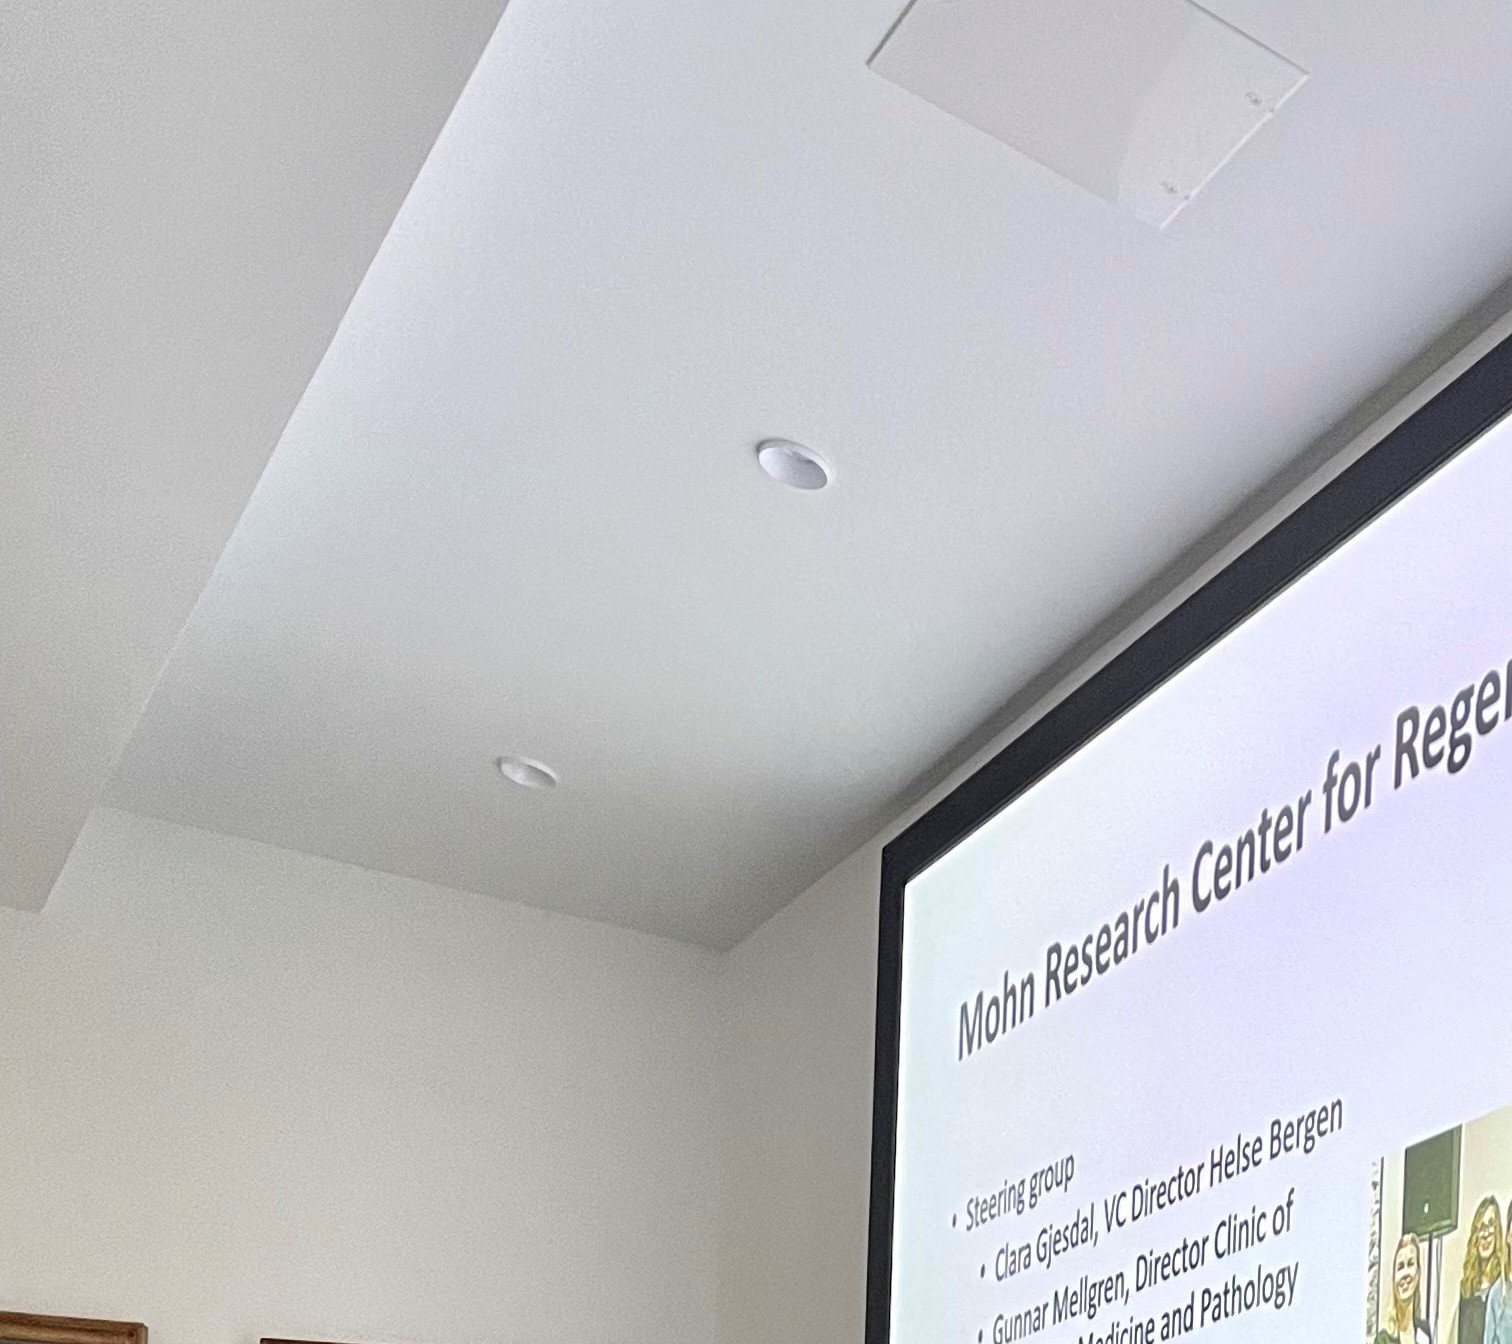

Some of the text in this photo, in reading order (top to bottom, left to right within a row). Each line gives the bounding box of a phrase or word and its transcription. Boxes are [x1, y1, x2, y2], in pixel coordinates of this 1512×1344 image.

[958, 971, 1034, 1060] Mohn
[1044, 864, 1180, 1008] Research
[1192, 790, 1312, 912] Center
[1323, 744, 1381, 833] for
[966, 1153, 1076, 1232] Steering group
[994, 1098, 1343, 1282] Clara Gjesdal, VC Director Helse Bergen
[1053, 1268, 1130, 1320] Mellgren,
[1135, 1233, 1210, 1292] Director
[1214, 1206, 1267, 1259] Clinic
[1271, 1187, 1295, 1238] of
[1160, 1291, 1195, 1343] and
[1200, 1261, 1300, 1328] Pathology
